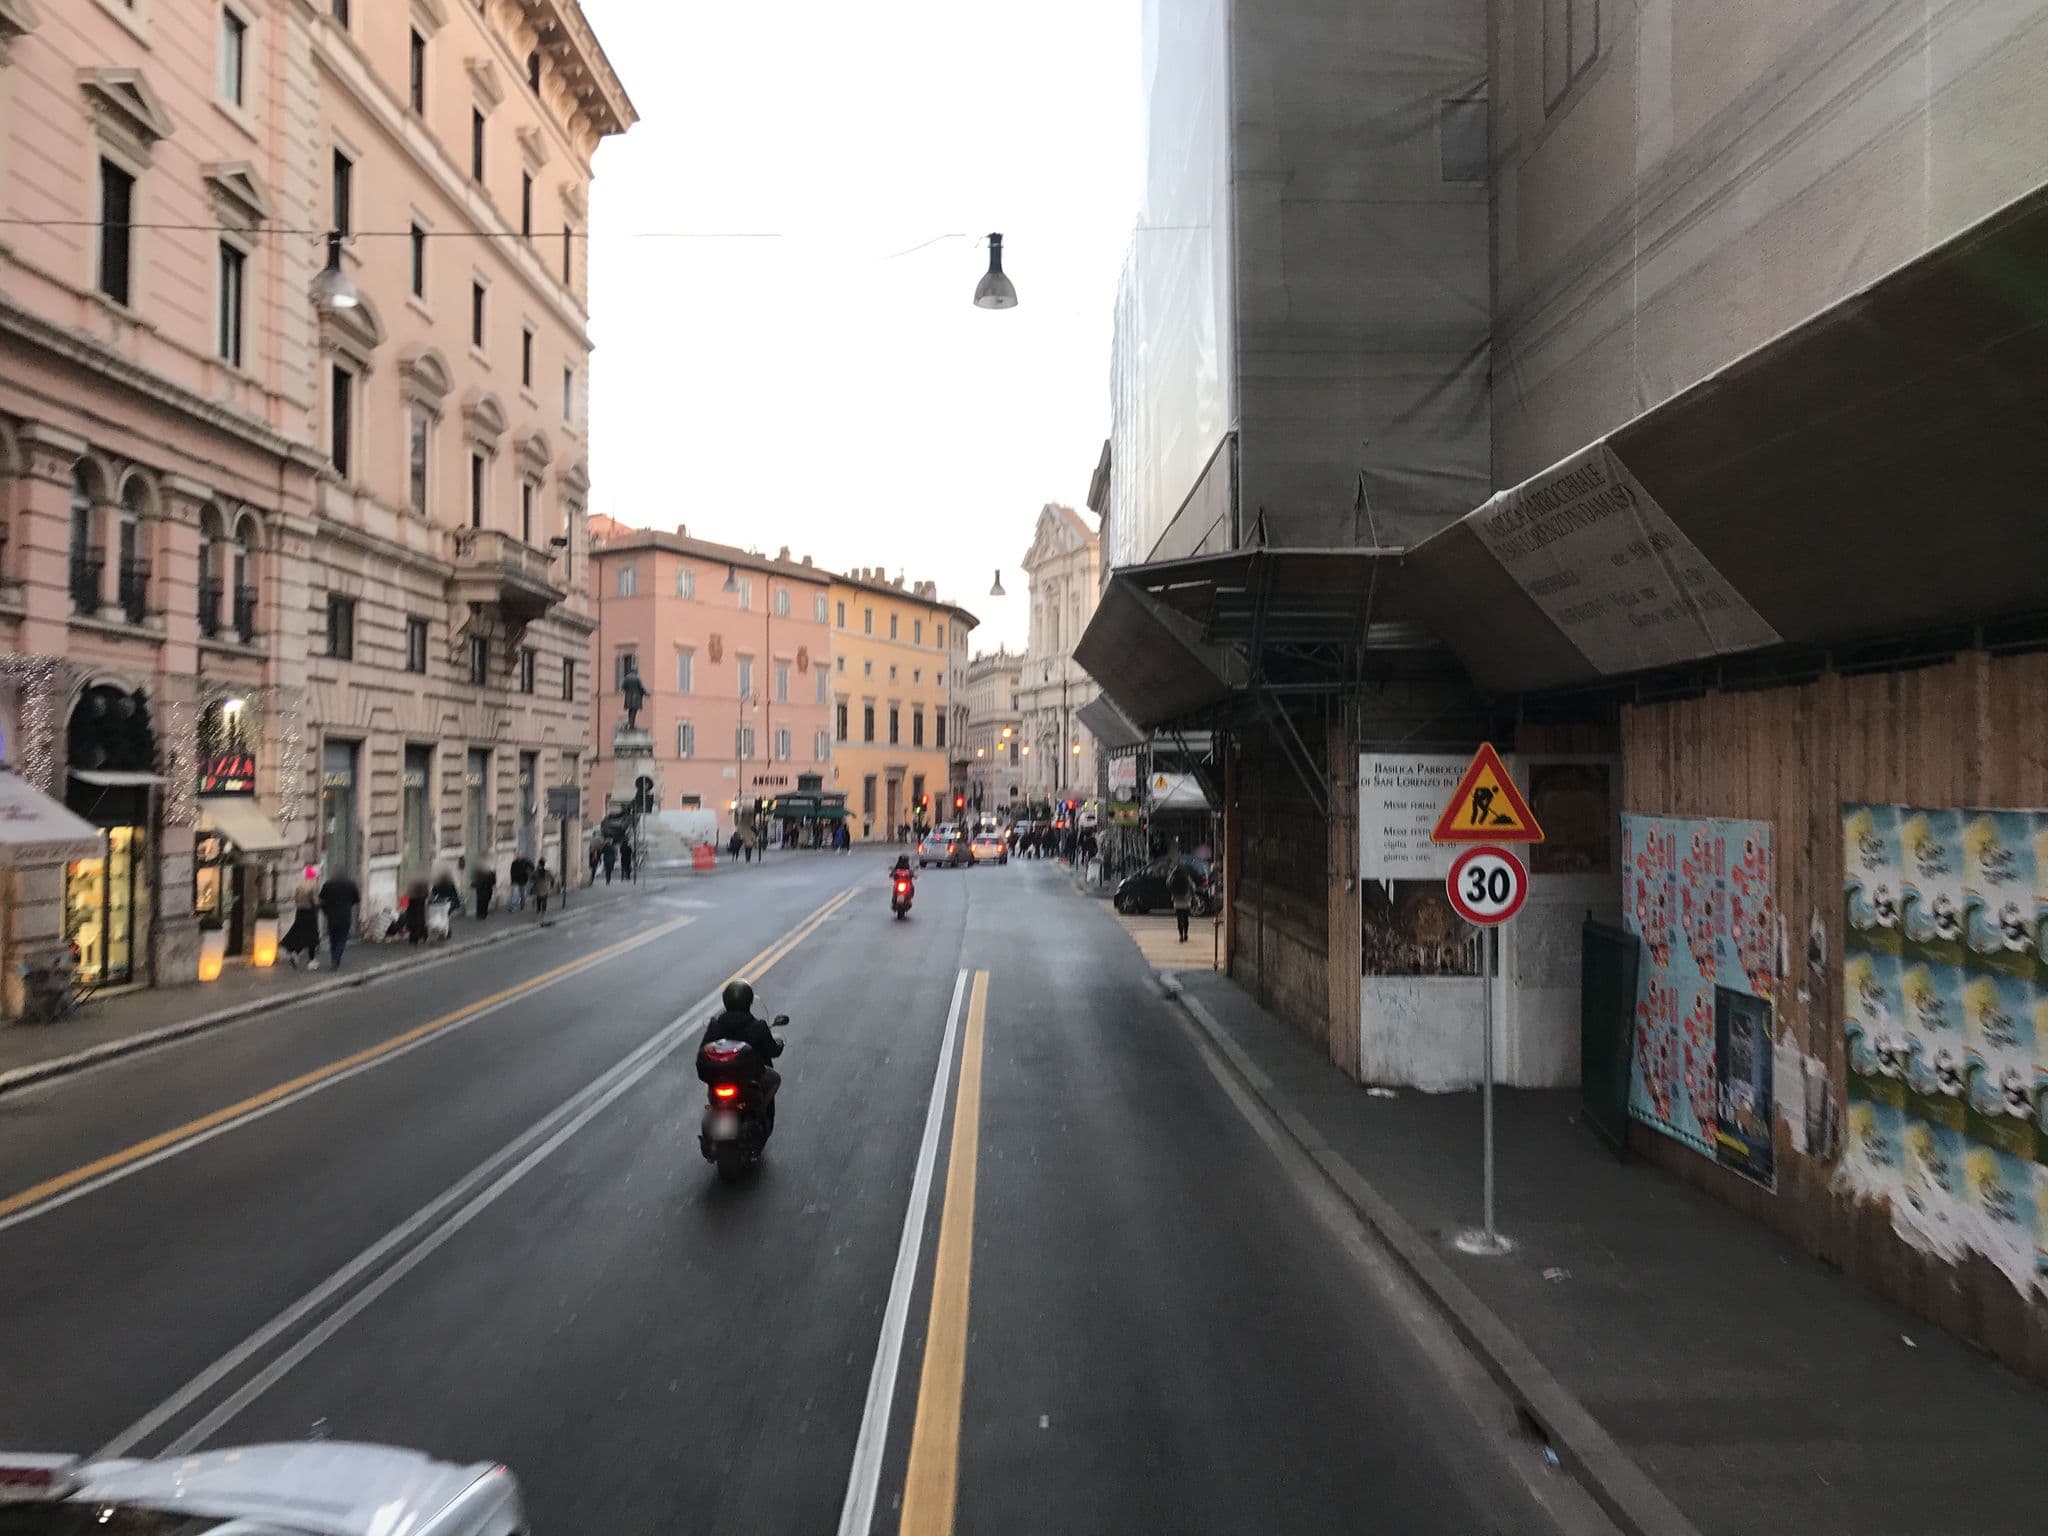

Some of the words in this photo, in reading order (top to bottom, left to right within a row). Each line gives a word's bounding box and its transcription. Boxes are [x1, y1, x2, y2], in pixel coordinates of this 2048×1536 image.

[1579, 482, 1638, 523] DAMASO
[1374, 763, 1415, 774] BASILICA
[1417, 763, 1467, 774] PARROCCH
[1374, 775, 1393, 787] SAN
[1397, 775, 1441, 787] LORENZO
[1443, 777, 1453, 787] IN
[1466, 866, 1510, 904] 30
